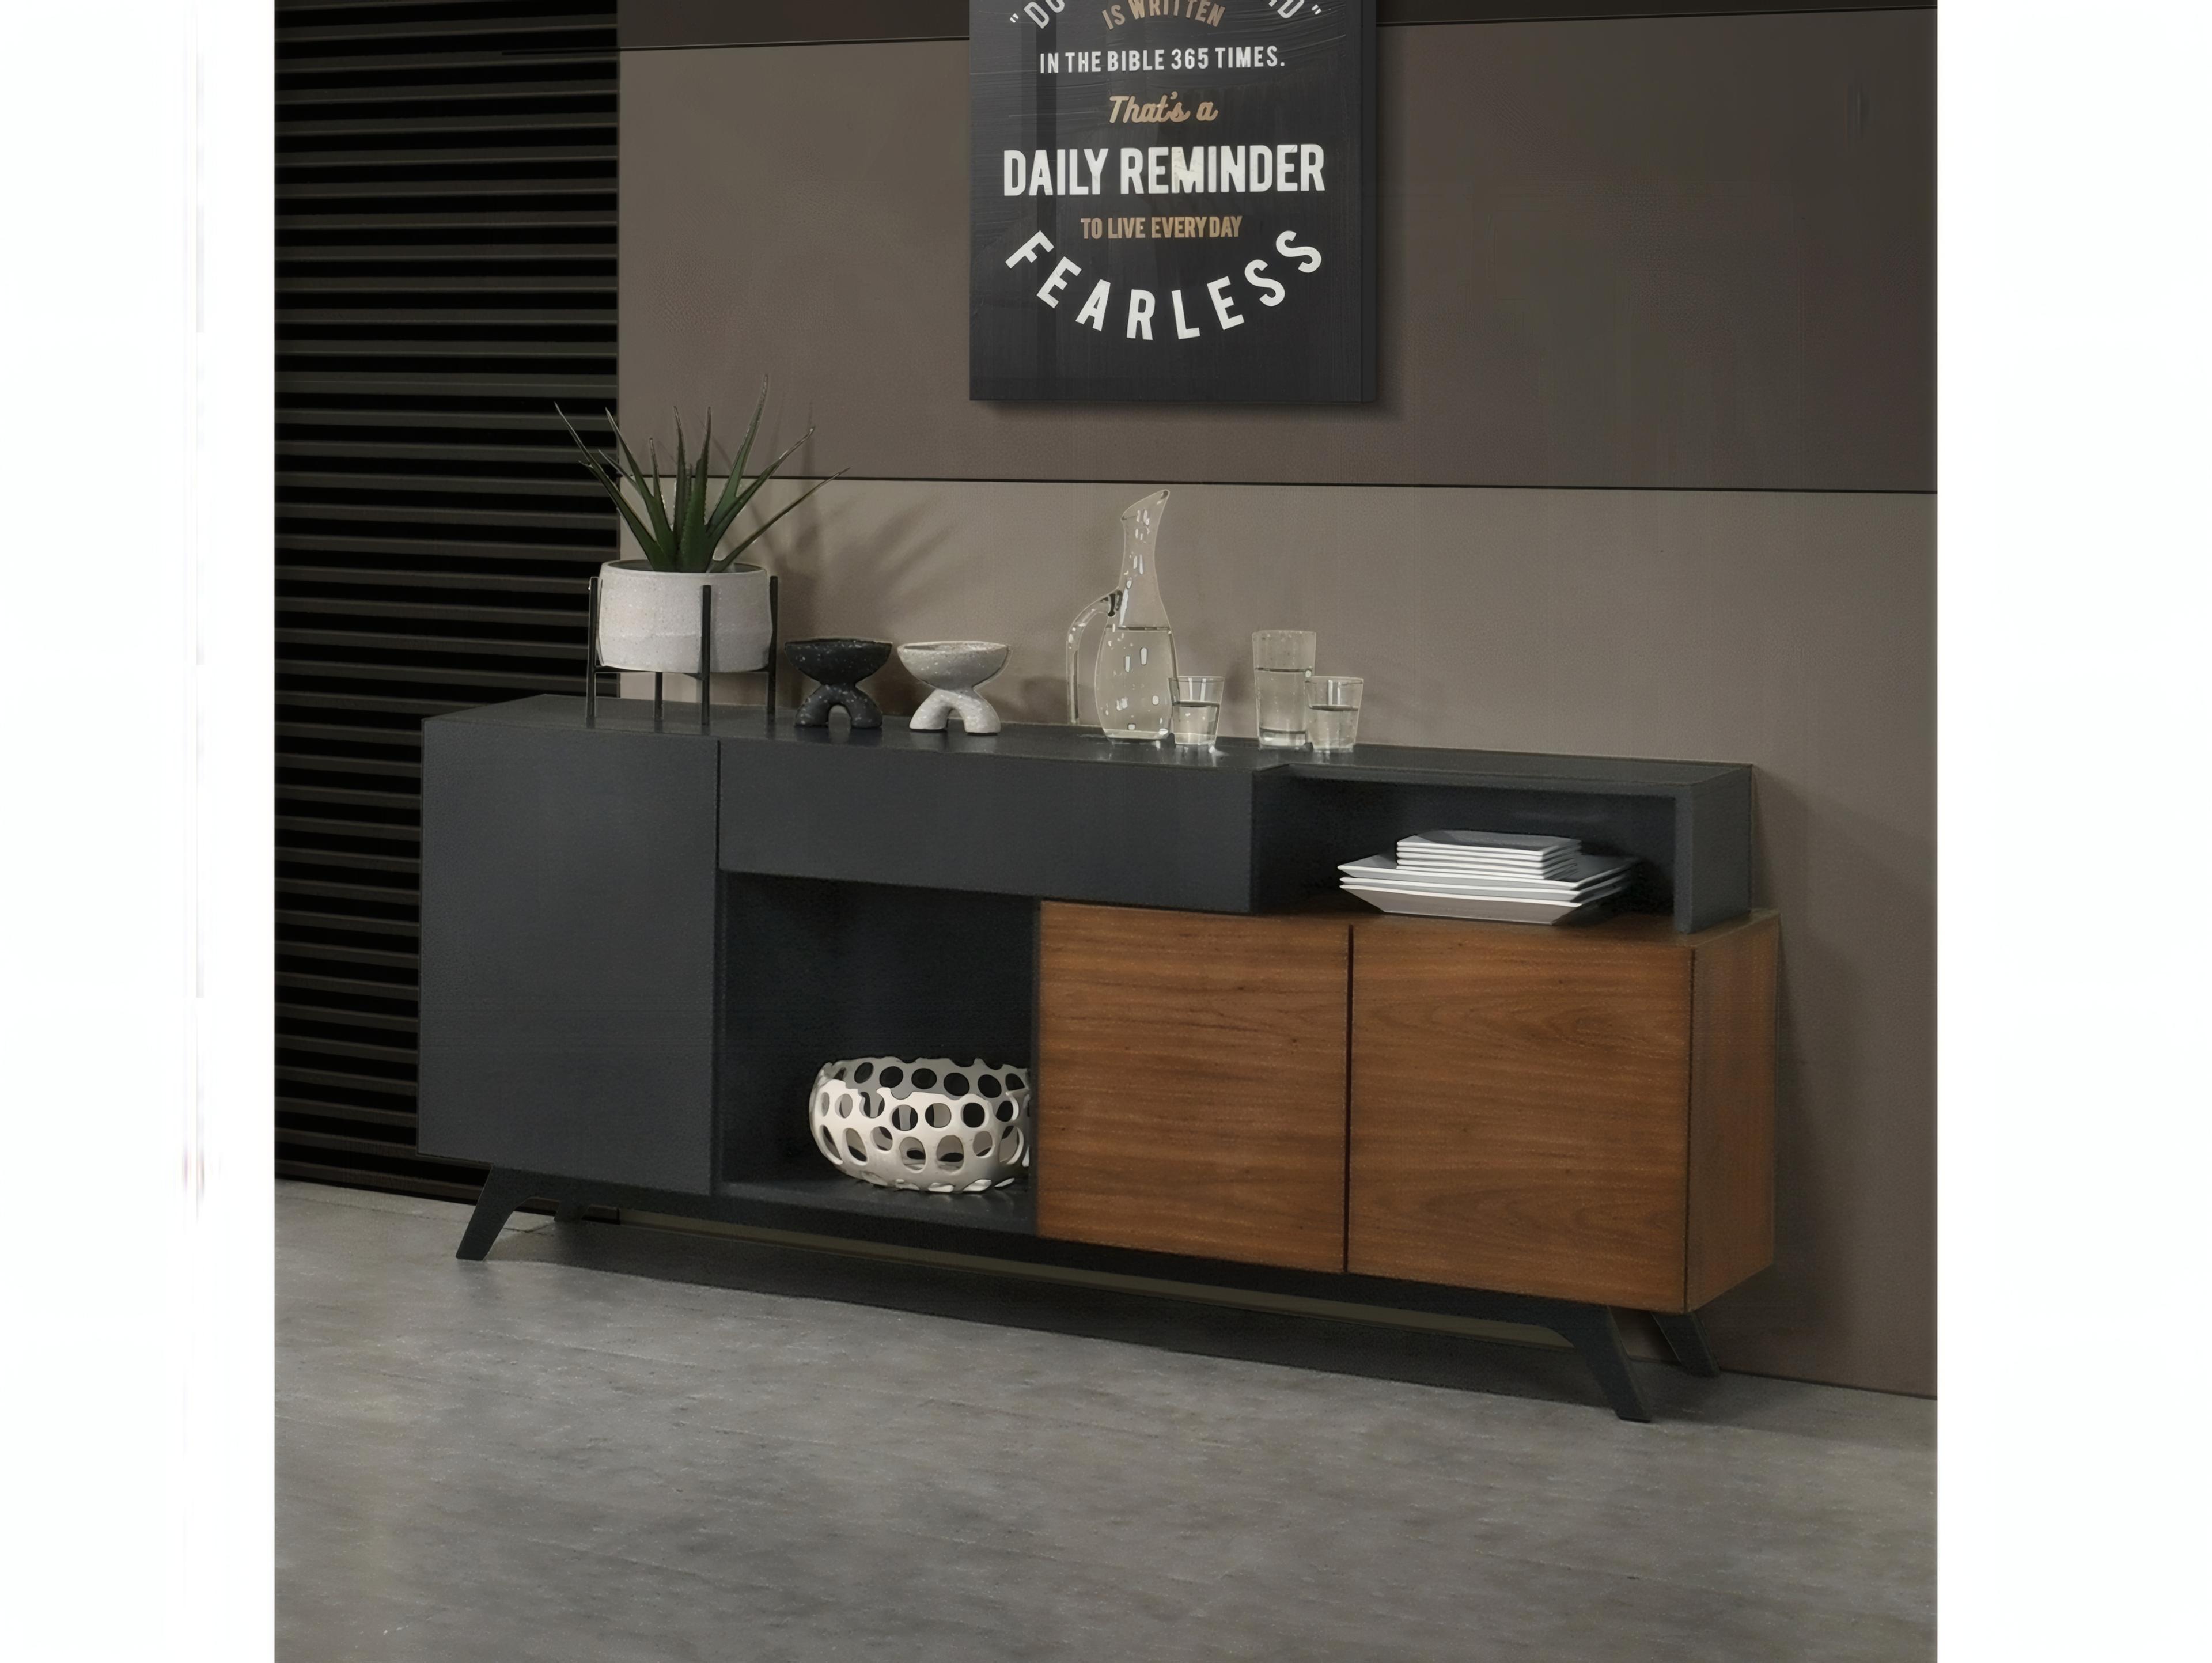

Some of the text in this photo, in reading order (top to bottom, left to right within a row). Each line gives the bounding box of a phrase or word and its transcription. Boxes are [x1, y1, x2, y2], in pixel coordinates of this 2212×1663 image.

[1101, 0, 1226, 30] IS WRITTEN
[1040, 46, 1285, 73] IN THE BIBLE 365 TIMES.
[1109, 91, 1219, 124] That's a
[1003, 143, 1325, 196] DAILY REMINDER
[1080, 218, 1103, 239] TO
[1108, 217, 1146, 238] LIVE
[1005, 230, 1322, 340] FEARLESS
